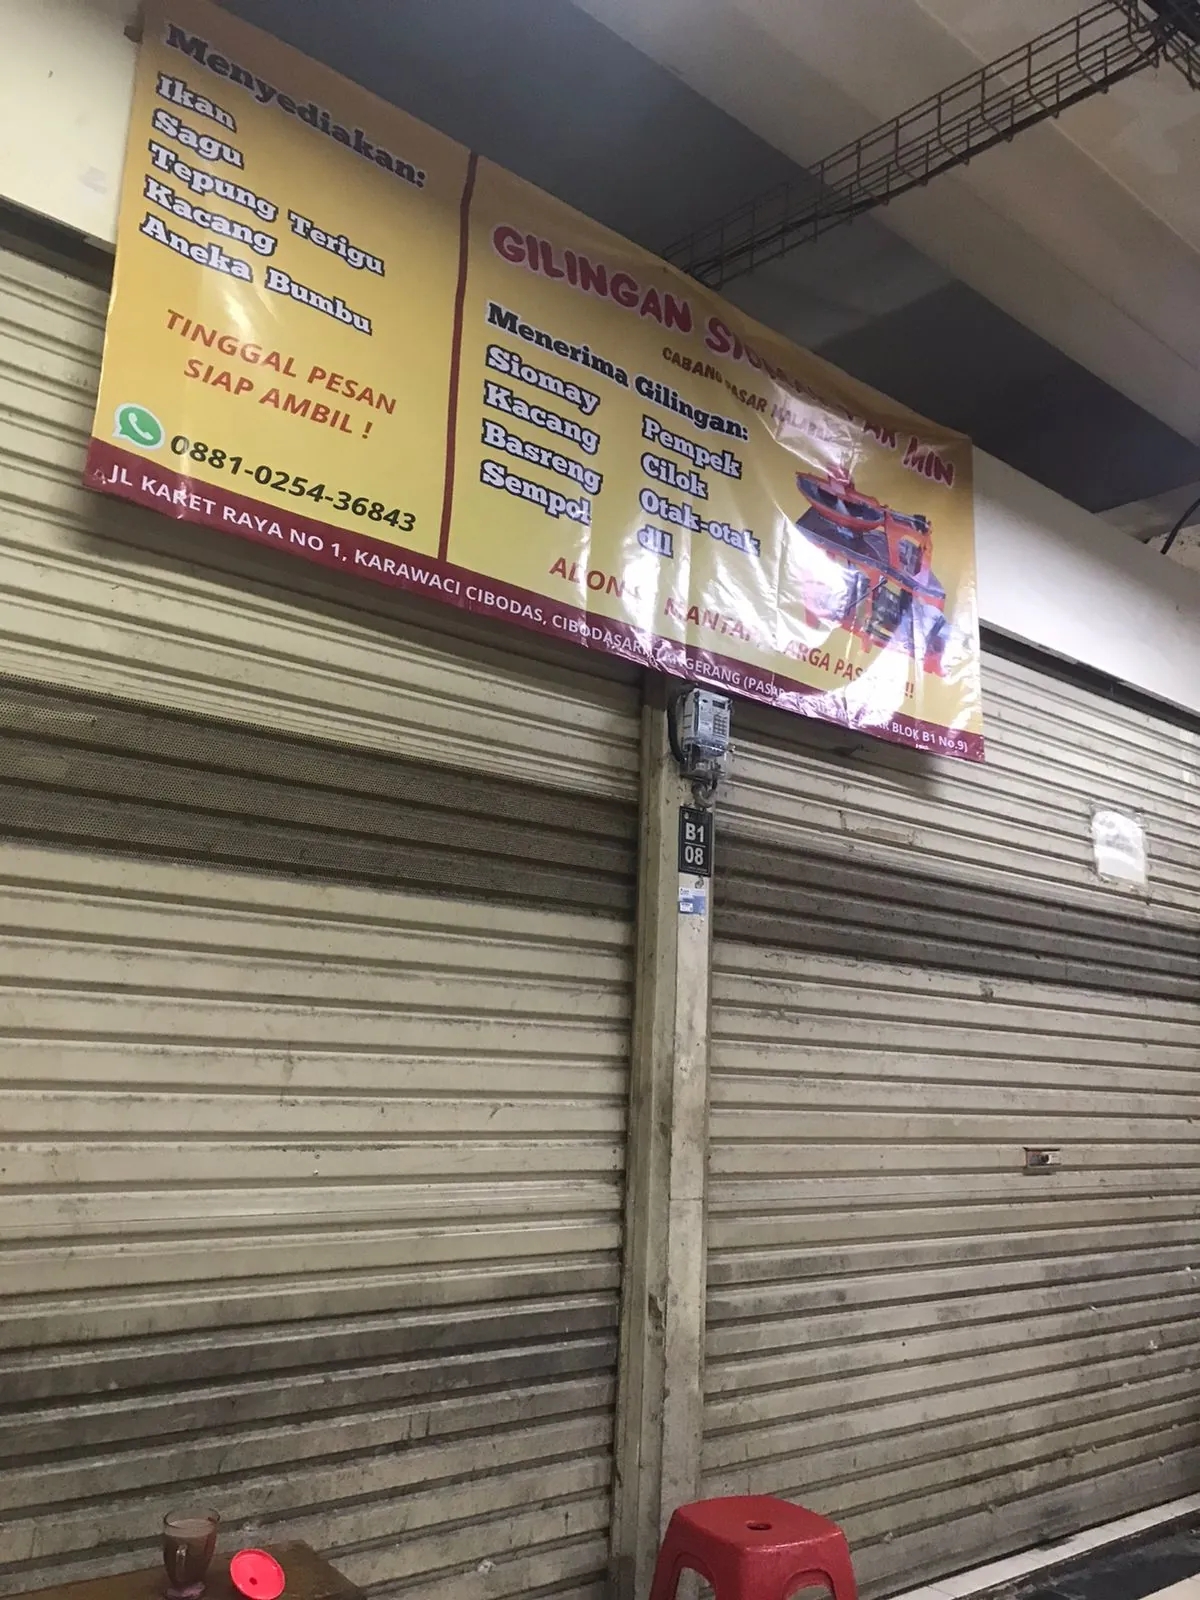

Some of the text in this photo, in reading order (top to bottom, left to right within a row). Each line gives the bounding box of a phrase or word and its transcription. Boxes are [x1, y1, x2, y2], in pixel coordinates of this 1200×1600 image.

[152, 108, 243, 169] Sagu
[156, 71, 237, 133] Ikan
[165, 23, 426, 189] Menyediakan:
[144, 175, 277, 255] Kacang
[149, 141, 384, 276] Tepung Terigu
[140, 213, 372, 335] Aneka Bumbu
[492, 225, 693, 333] GILINGAN
[167, 309, 396, 414] TINGGAL PESAN
[183, 359, 254, 395] SIAP
[259, 388, 352, 434] AMBIL
[486, 344, 600, 415] Siomay
[487, 301, 749, 441] Menerima Gilingan:
[484, 379, 600, 455] Kacang
[642, 415, 742, 479] Pempek
[170, 435, 416, 532] 0881-0254-36843
[480, 459, 592, 526] Sempol
[482, 418, 603, 495] Basreng
[641, 452, 708, 499] Cilok
[637, 525, 673, 559] dll
[639, 488, 761, 556] Otak-otak
[107, 464, 133, 487] JL
[142, 476, 216, 514] KARET
[223, 506, 283, 539] RAYA
[290, 529, 324, 550] NO
[331, 543, 347, 562] 1,
[354, 549, 460, 595] KARAWACI
[466, 586, 546, 625] CIBODAS,
[552, 615, 650, 657] CIBODASAR
[655, 640, 741, 685] ANGERANG
[892, 721, 919, 742] BLOK
[922, 731, 936, 743] B1
[776, 635, 829, 672] ARGA
[684, 845, 704, 865] 08
[685, 822, 704, 842] B1
